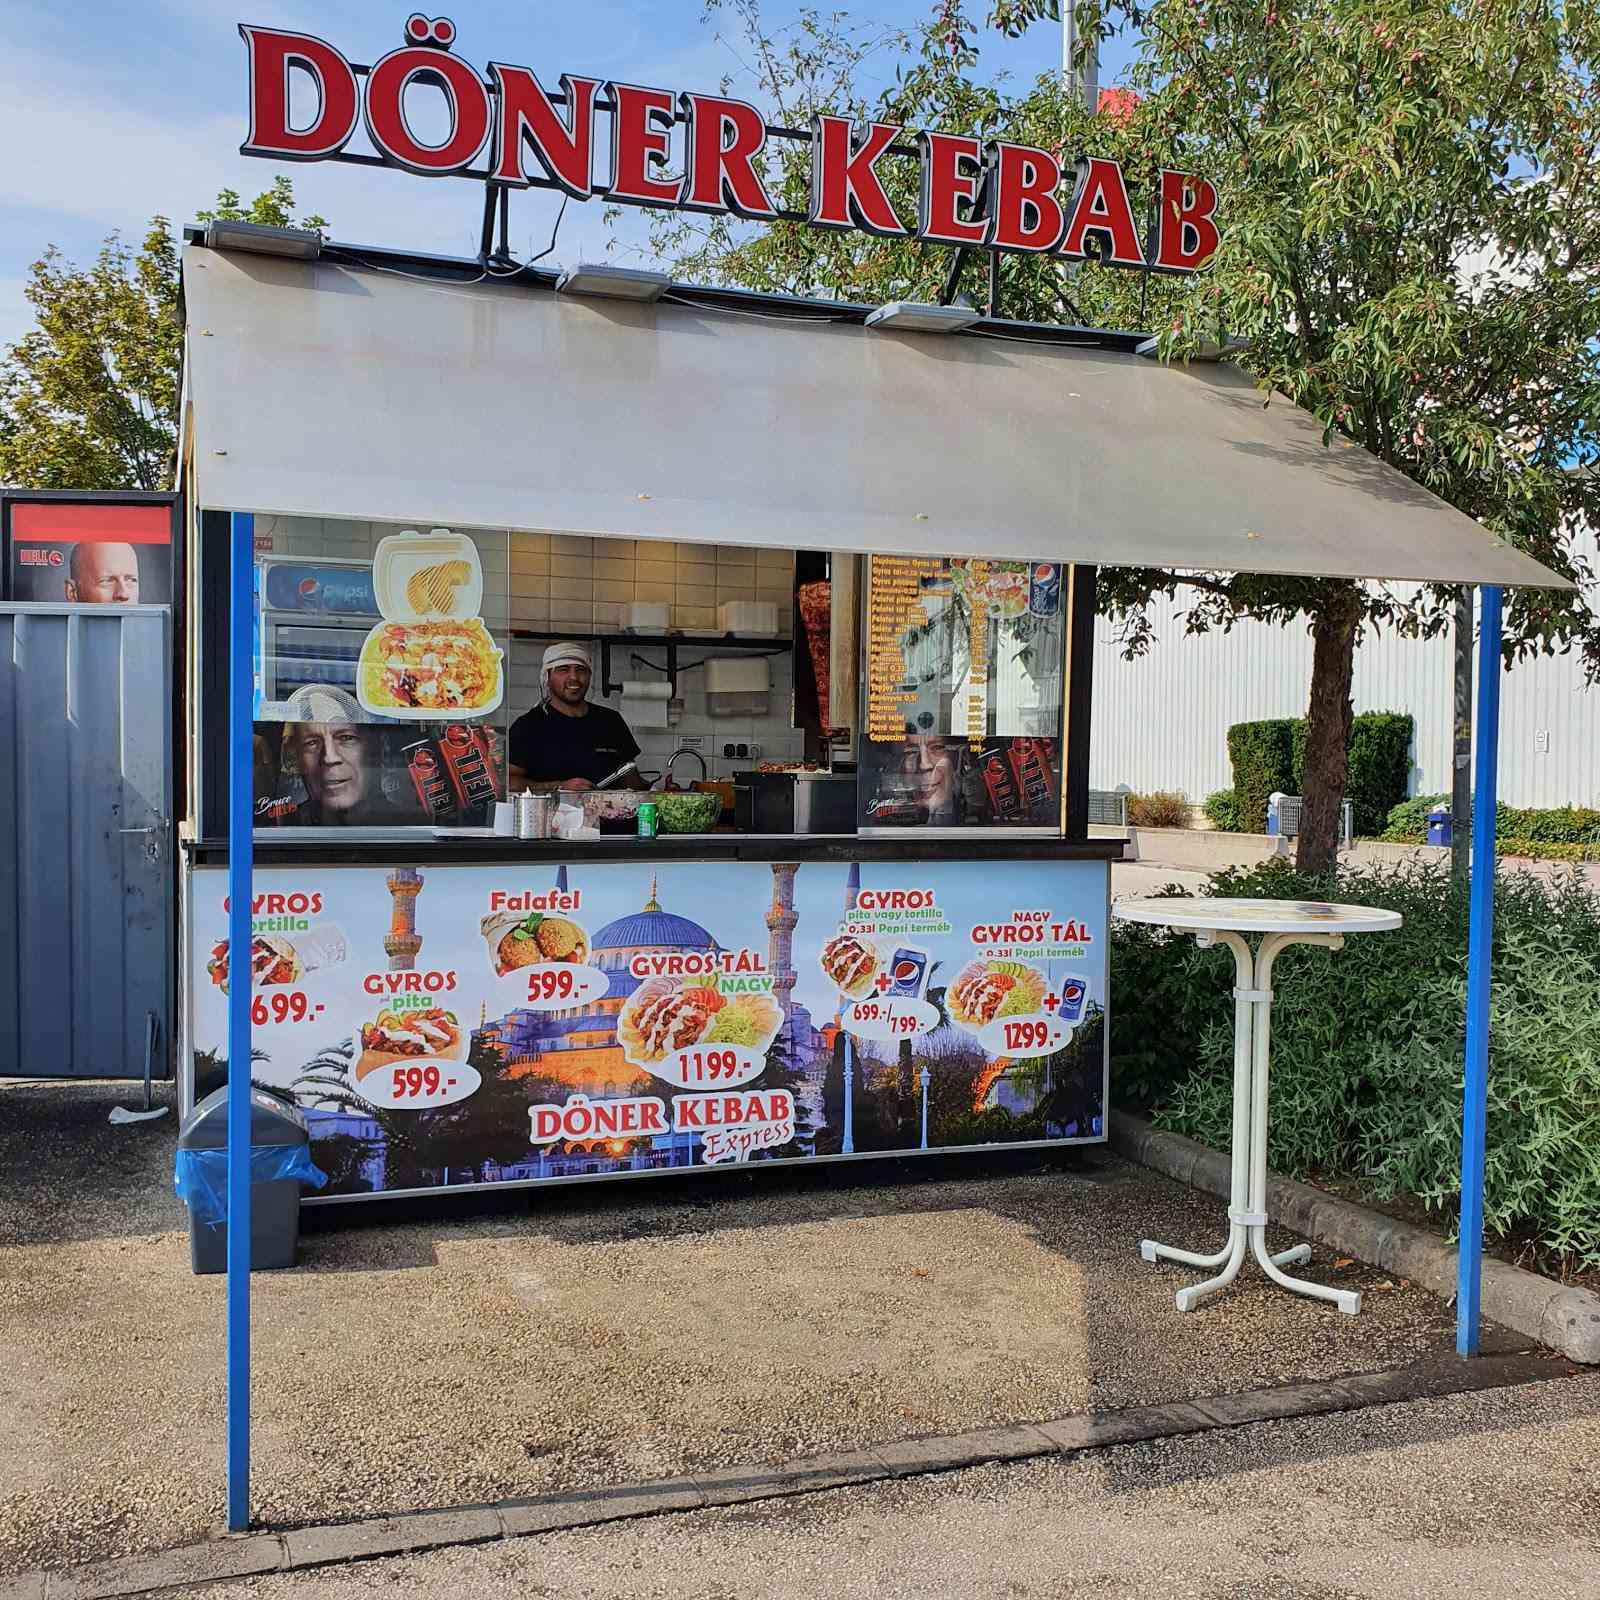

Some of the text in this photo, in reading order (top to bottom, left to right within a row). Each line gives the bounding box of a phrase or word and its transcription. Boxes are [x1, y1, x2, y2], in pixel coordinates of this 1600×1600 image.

[238, 13, 1221, 275] DÖNER KEBAB
[491, 890, 580, 911] Falafel
[859, 891, 933, 909] GYROS
[848, 909, 942, 921] pita vagy tortilla
[1014, 912, 1050, 923] NAGY
[878, 923, 908, 934] Pepsi
[911, 922, 950, 933] termék
[972, 920, 1091, 944] GYROS TÁL
[632, 950, 765, 976] GYROS TÁL
[1015, 949, 1043, 959] Pepsi
[1046, 947, 1085, 958] termék
[364, 971, 456, 994] GYROS
[527, 970, 588, 1002] 599.-
[721, 978, 772, 993] NAGY
[251, 992, 325, 1025] 699.-
[392, 994, 433, 1011] pita
[1004, 1021, 1061, 1049] 1299.-
[680, 1050, 751, 1082] 1199.-
[392, 1066, 456, 1098] 599.-
[537, 1094, 789, 1138] DÖNER KEBAB
[706, 1120, 790, 1160] Express
